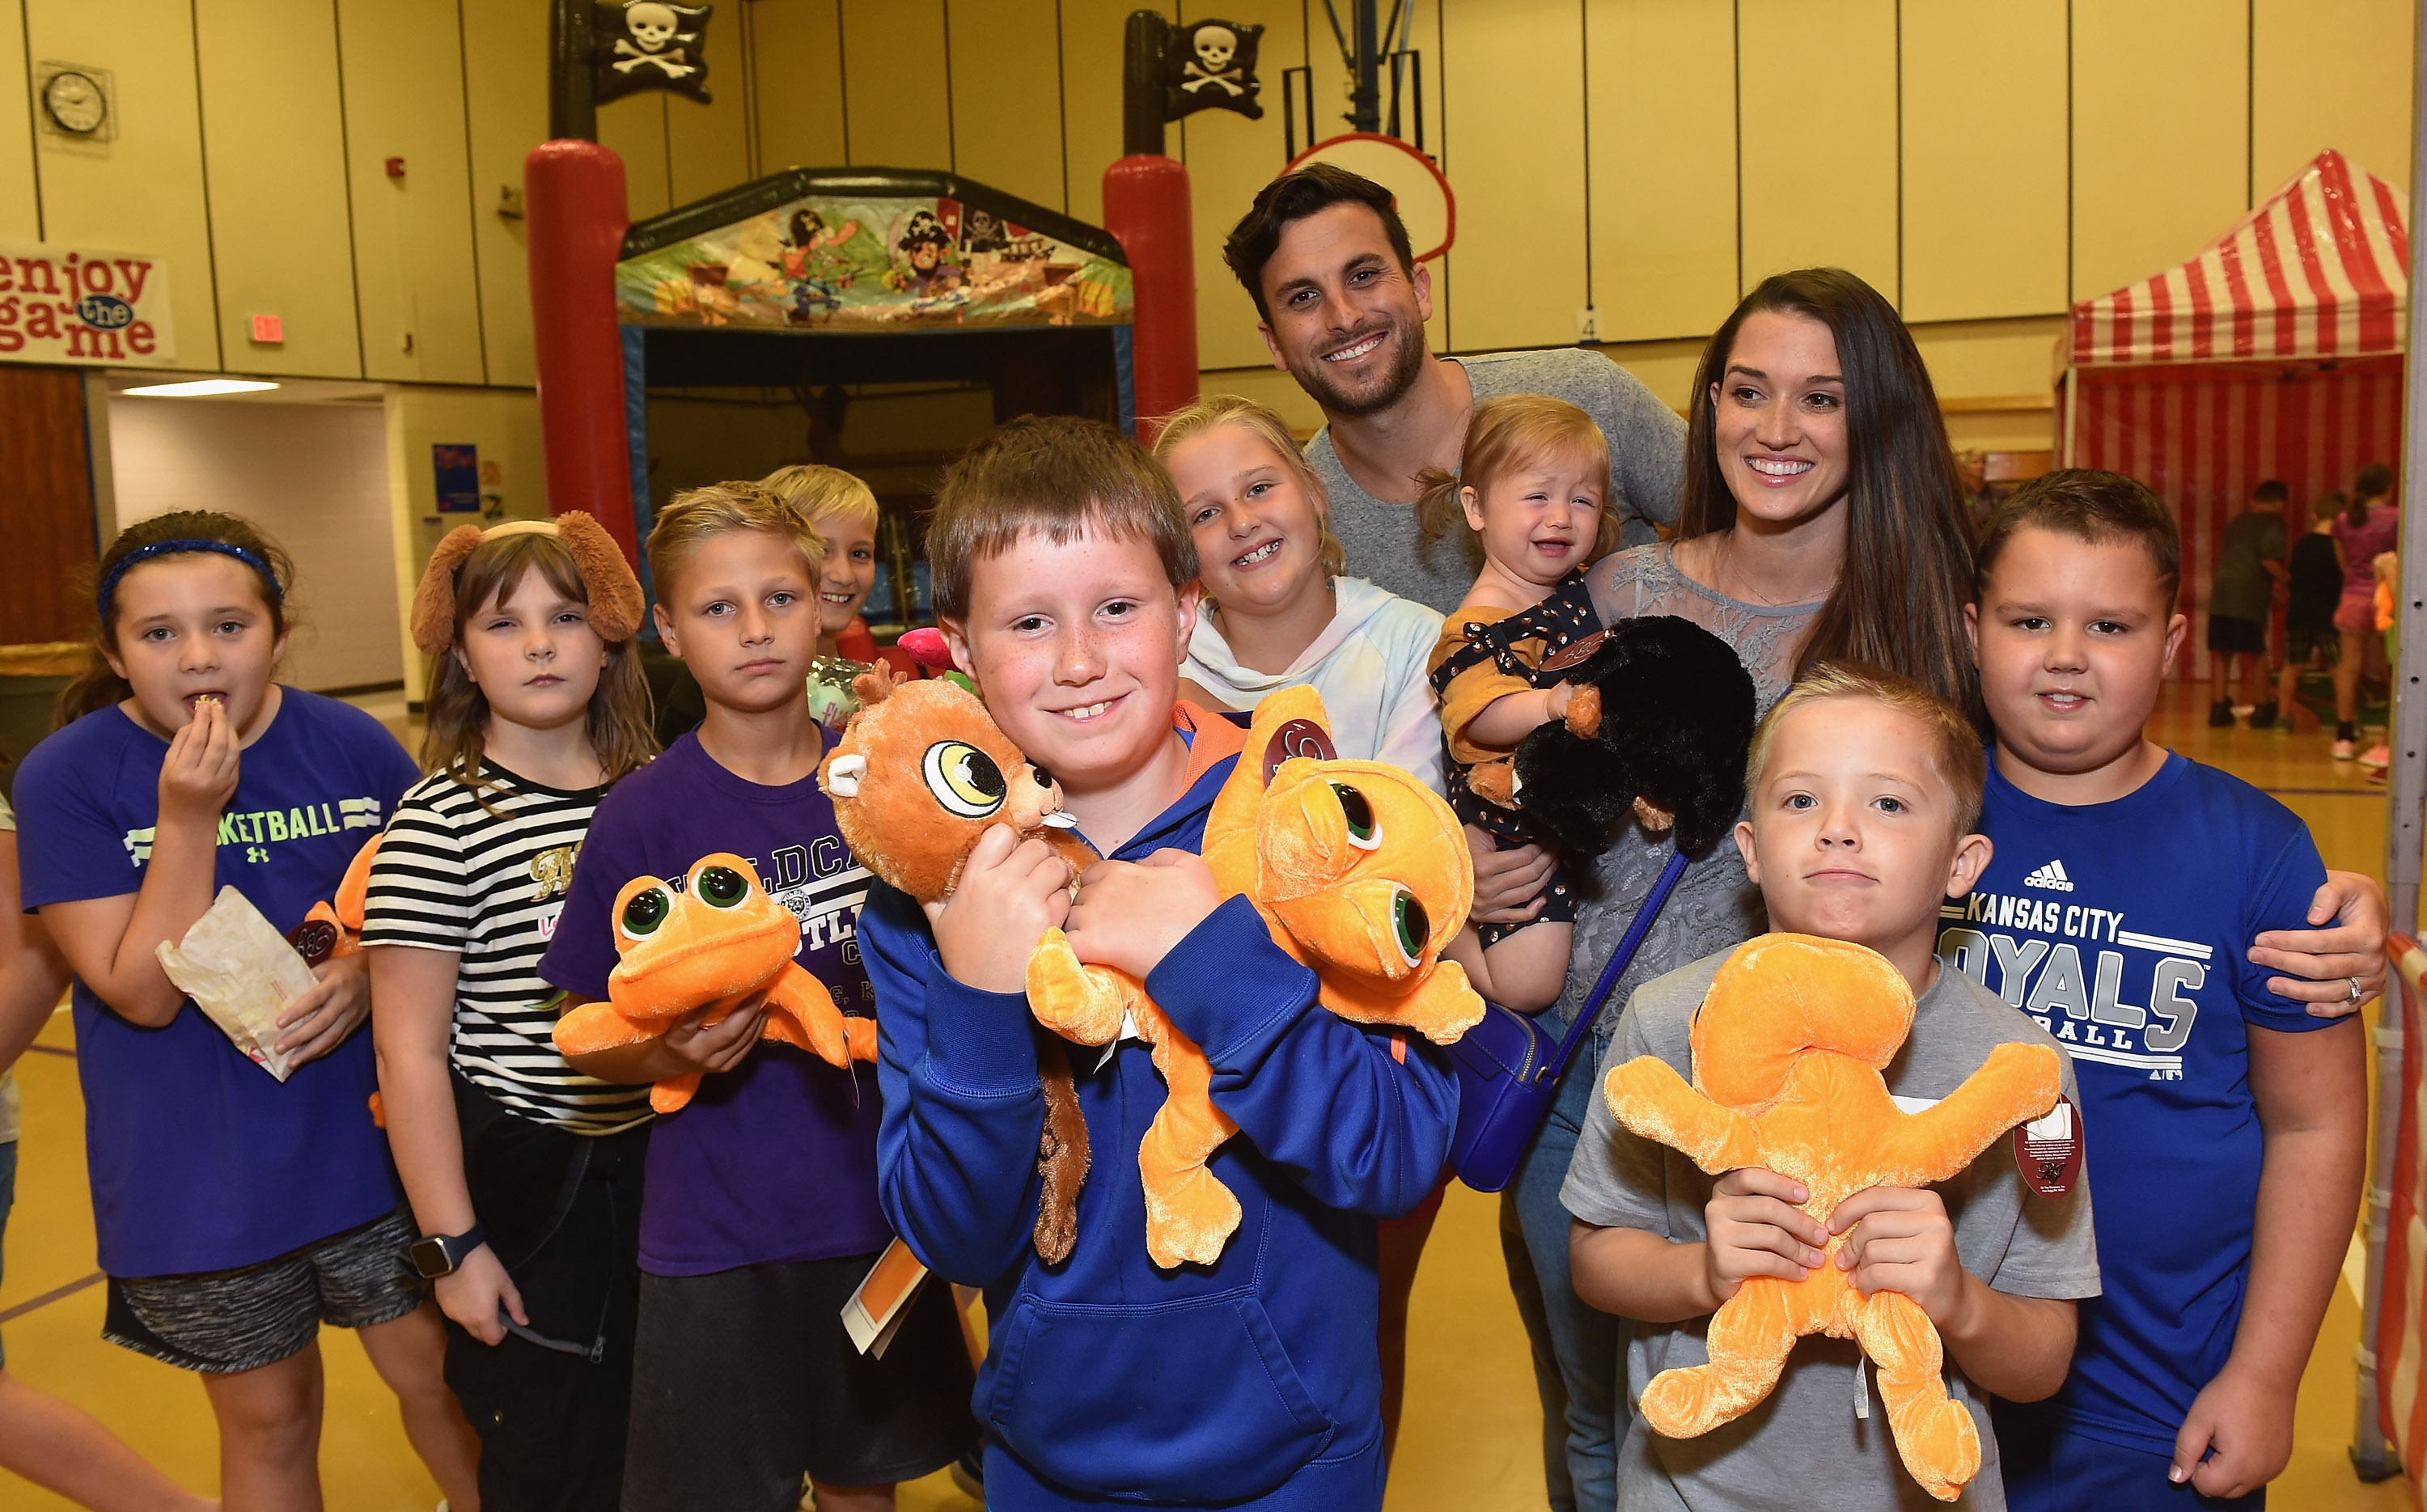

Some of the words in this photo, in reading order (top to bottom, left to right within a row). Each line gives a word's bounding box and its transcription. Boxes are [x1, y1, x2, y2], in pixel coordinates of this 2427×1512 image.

[0, 252, 153, 315] enjoy
[0, 296, 156, 359] game
[81, 298, 130, 325] the
[1582, 319, 1595, 338] 4
[217, 803, 341, 847] KETBALL
[2024, 875, 2074, 892] adidas
[1967, 892, 2061, 934] KANSAS
[2065, 905, 2124, 943] CITY
[1938, 927, 2206, 1052] OYALS
[2031, 1015, 2133, 1050] BALL
